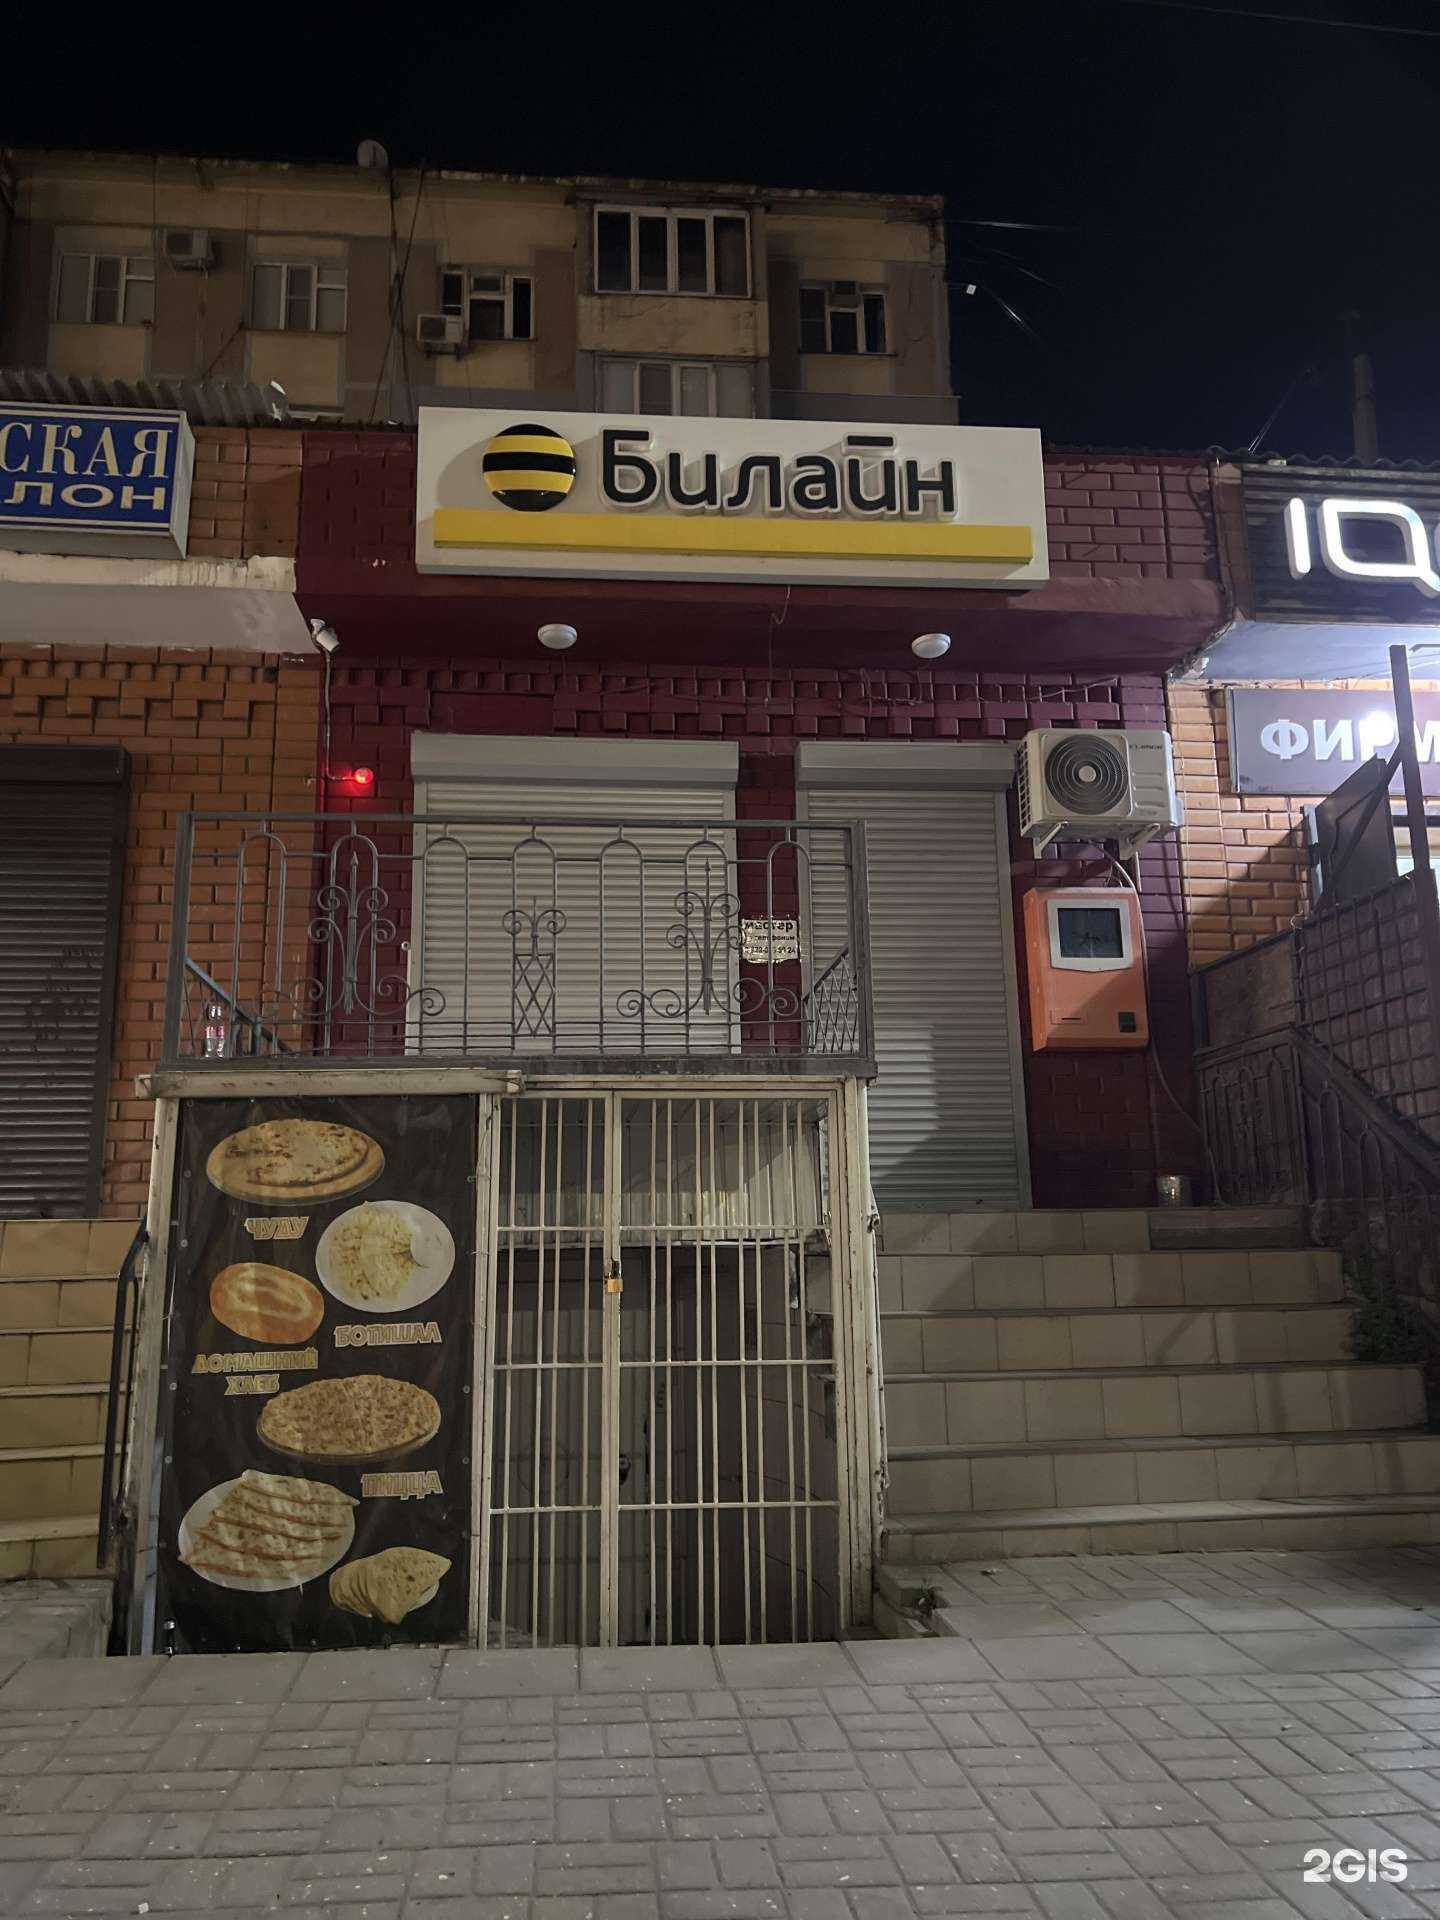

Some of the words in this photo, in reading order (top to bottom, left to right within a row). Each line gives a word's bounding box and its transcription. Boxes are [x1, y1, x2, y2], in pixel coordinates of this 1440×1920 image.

[0, 422, 173, 479] СКАЯ
[601, 427, 955, 514] Билайн
[3, 481, 166, 510] ЛОН
[1287, 497, 1440, 593] IQ
[245, 1216, 309, 1240] ЧУДУ
[224, 1374, 280, 1395] ХЛЕБ
[361, 1471, 443, 1500] ПИЦЦА
